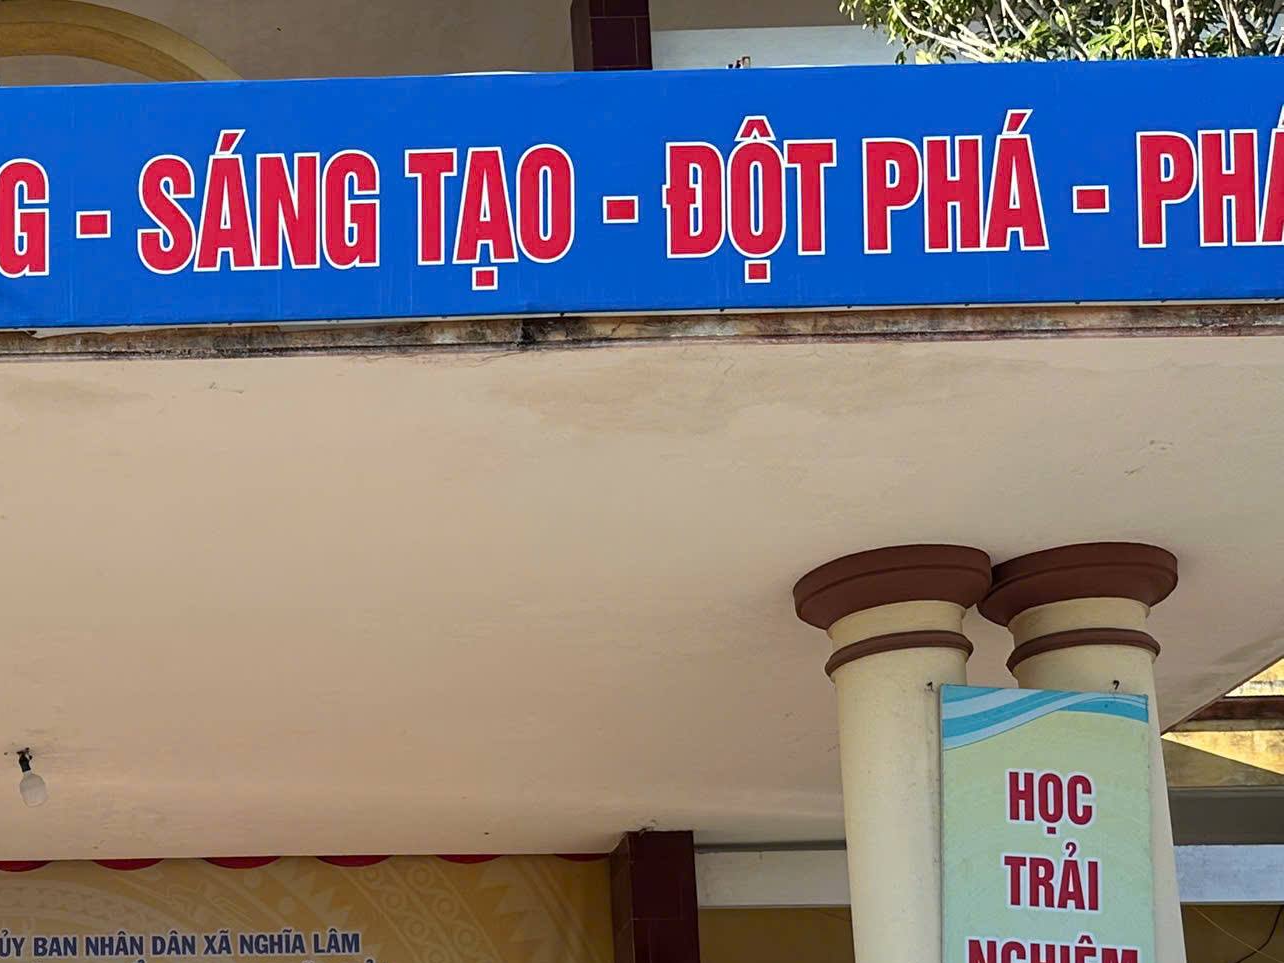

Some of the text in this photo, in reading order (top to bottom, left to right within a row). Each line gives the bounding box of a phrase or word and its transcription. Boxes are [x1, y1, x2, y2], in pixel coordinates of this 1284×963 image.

[137, 128, 380, 276] SÁNG
[405, 143, 575, 291] TẠO
[662, 114, 837, 284] ĐỘT
[862, 108, 1049, 255] PHÁ
[1007, 770, 1093, 835] HỌC
[1003, 842, 1100, 912] TRẢI
[34, 936, 77, 957] BAN
[86, 930, 144, 956] NHÂN
[153, 930, 196, 956] DÂN
[203, 930, 232, 955] XÃ
[240, 928, 306, 955] NGHĨA
[314, 928, 360, 953] LÂM
